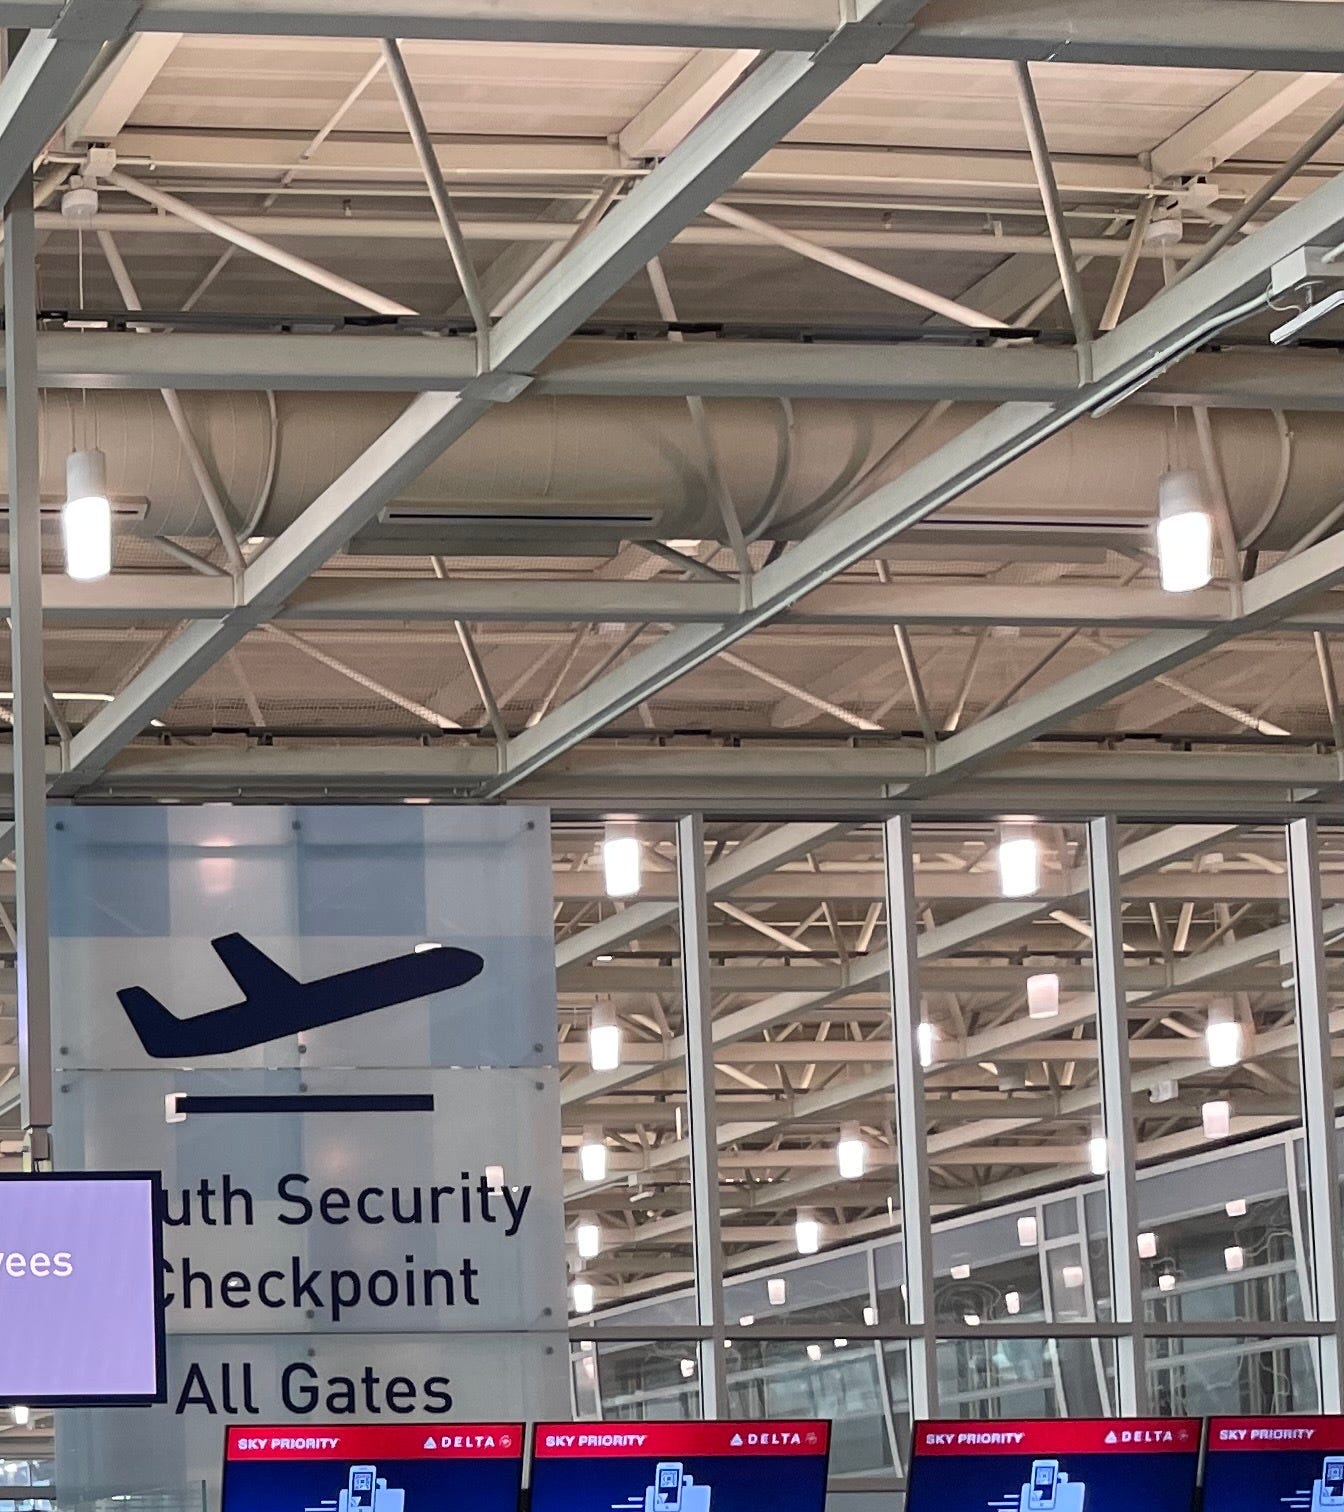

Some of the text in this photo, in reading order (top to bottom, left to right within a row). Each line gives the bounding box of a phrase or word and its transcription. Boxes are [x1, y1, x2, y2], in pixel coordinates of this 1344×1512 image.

[277, 1172, 530, 1236] Security
[176, 1362, 453, 1415] All Gates
[546, 1434, 646, 1447] SKY PRIORITY
[748, 1433, 802, 1445] DELTA
[926, 1433, 1024, 1445] SKY PRIORITY
[1121, 1430, 1173, 1442] DELTA
[1219, 1429, 1315, 1441] SKY PRIORITY
[237, 1437, 339, 1451] SKY PRIORITY
[441, 1436, 495, 1448] DELTA
